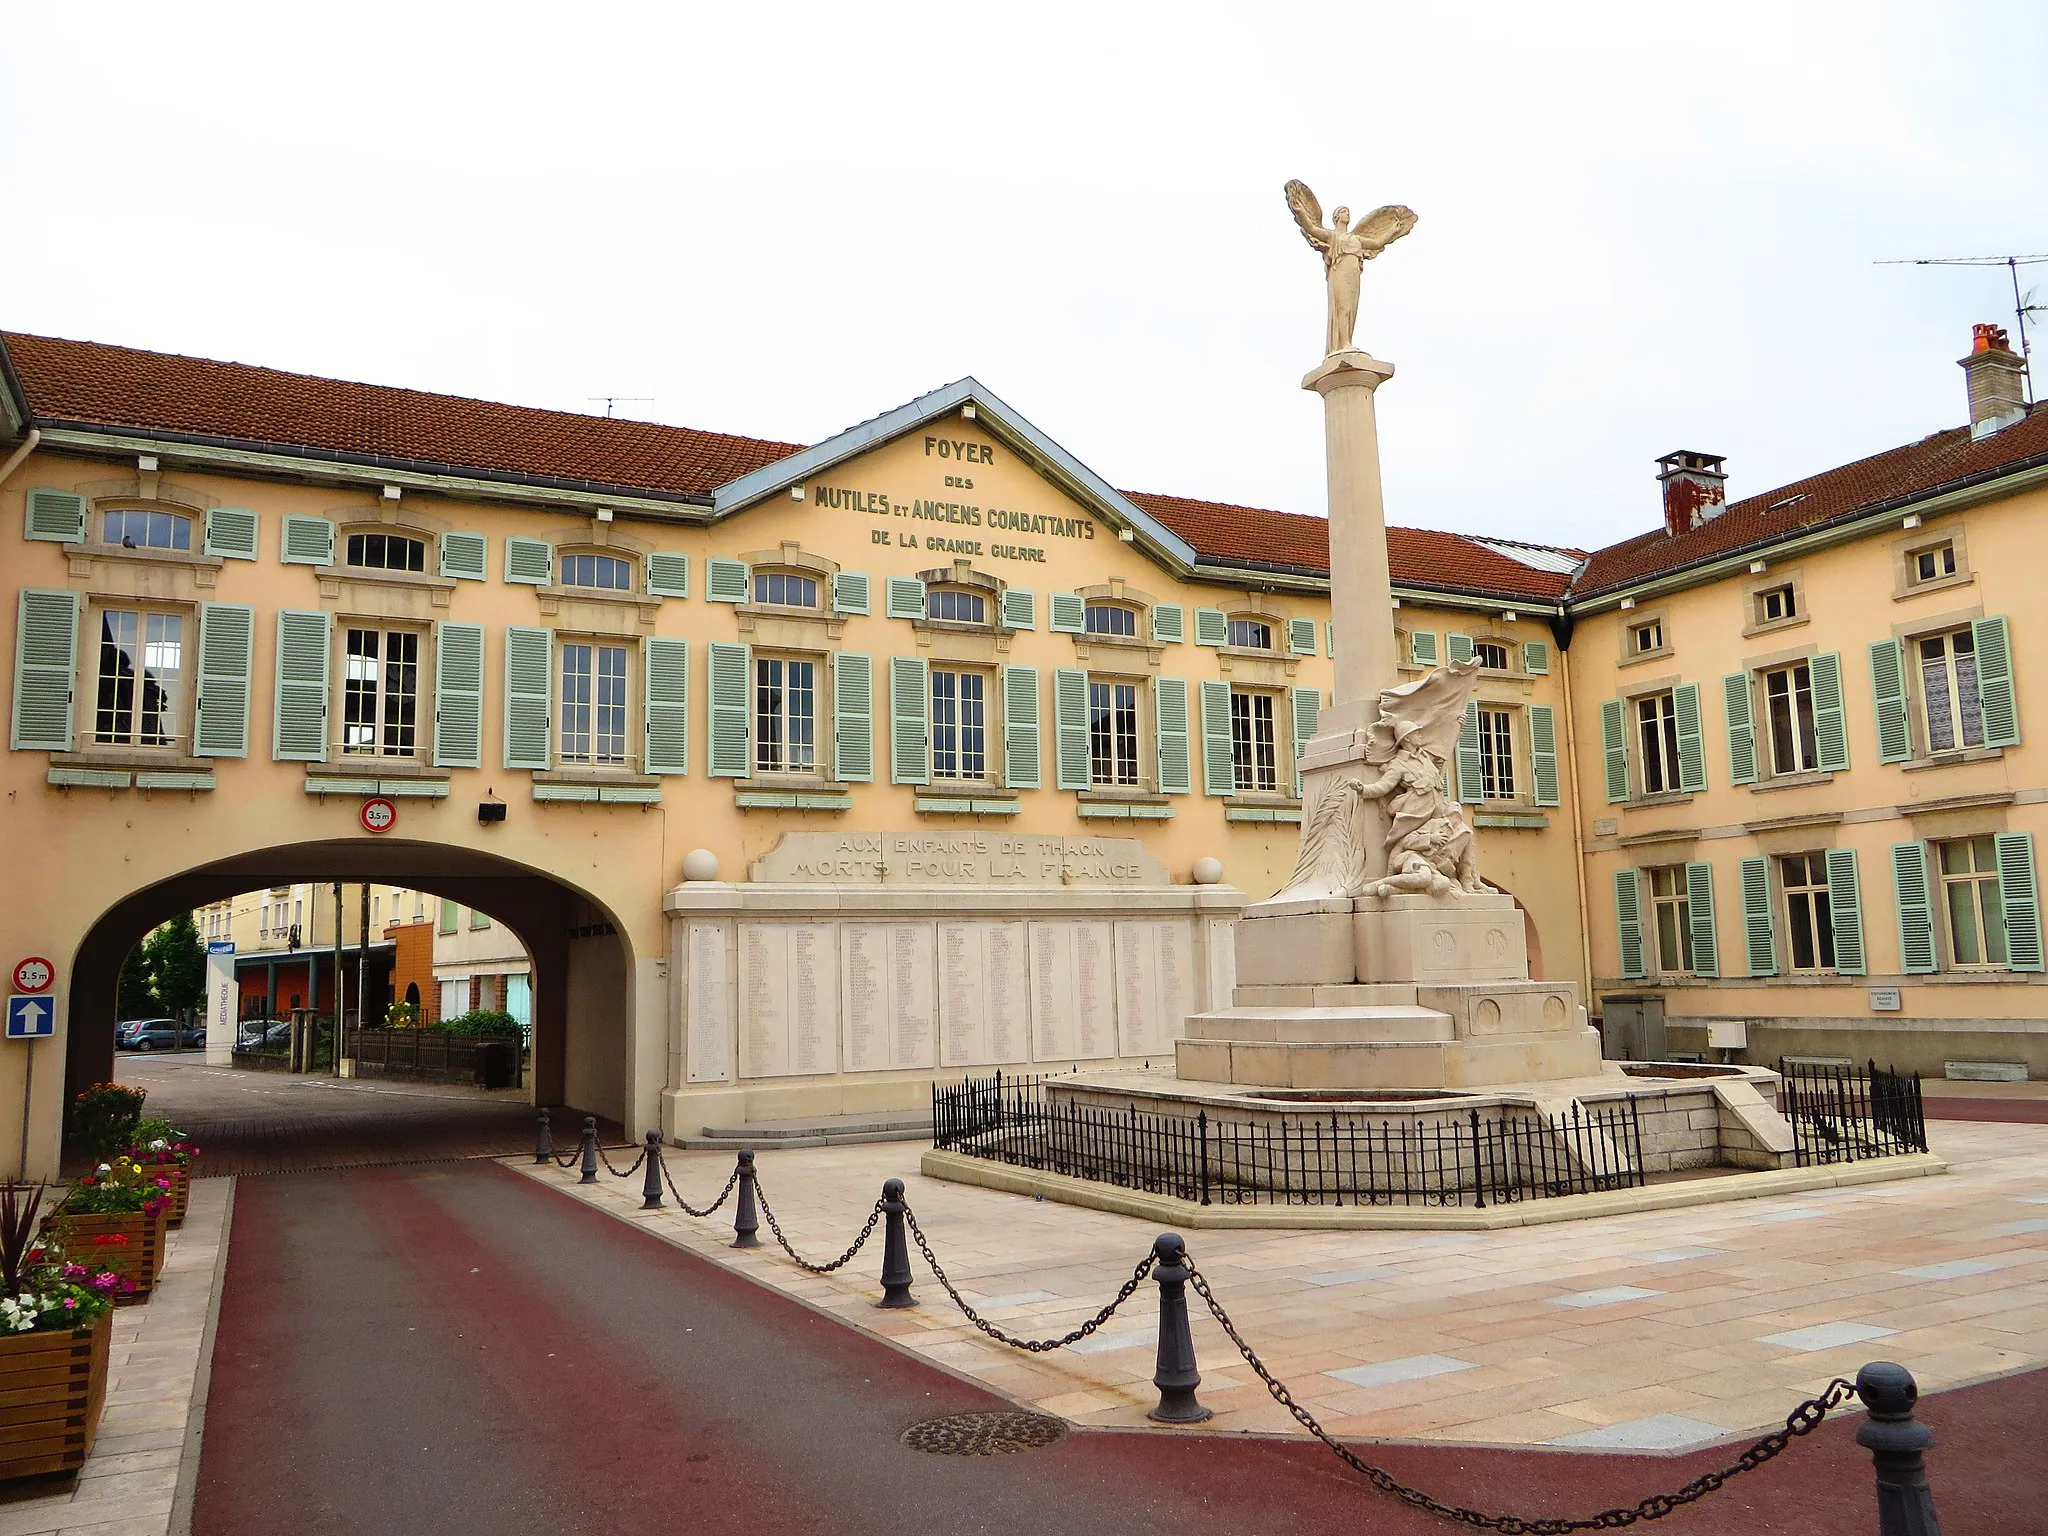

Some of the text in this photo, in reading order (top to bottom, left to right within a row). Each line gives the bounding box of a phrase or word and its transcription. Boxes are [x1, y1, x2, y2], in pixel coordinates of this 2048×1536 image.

[925, 436, 994, 465] FOYER
[945, 475, 974, 489] DES
[815, 486, 1095, 539] MUTILES ET ANCIENS COMBATTANTS
[871, 529, 1047, 562] DE LA GRANDE GUERRE
[836, 838, 1104, 856] AUX ENFANTS DE THAON
[791, 860, 1142, 879] MORTS POUR LA FRANCE
